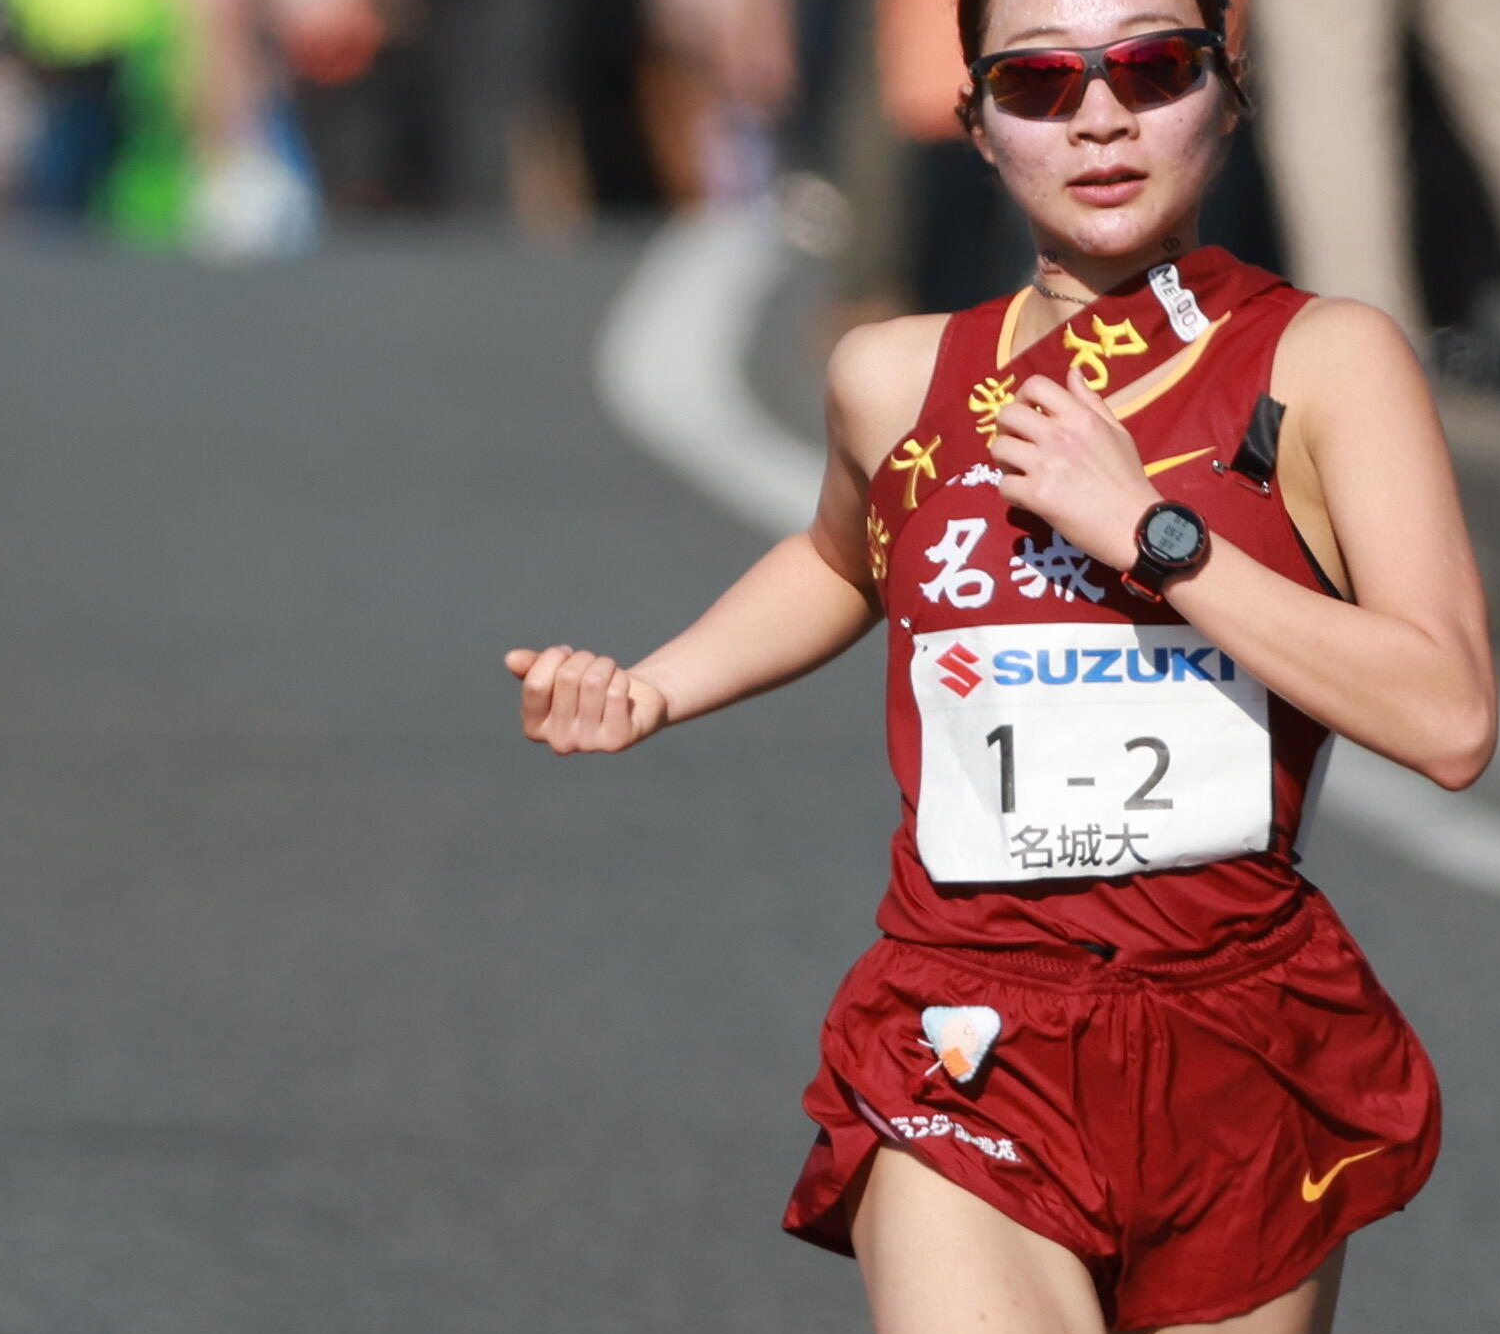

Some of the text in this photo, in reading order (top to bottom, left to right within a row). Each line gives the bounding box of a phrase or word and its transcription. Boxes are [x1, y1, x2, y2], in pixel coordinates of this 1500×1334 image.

[992, 646, 1235, 685] SUZUKI
[1010, 822, 1150, 869] 名城大
